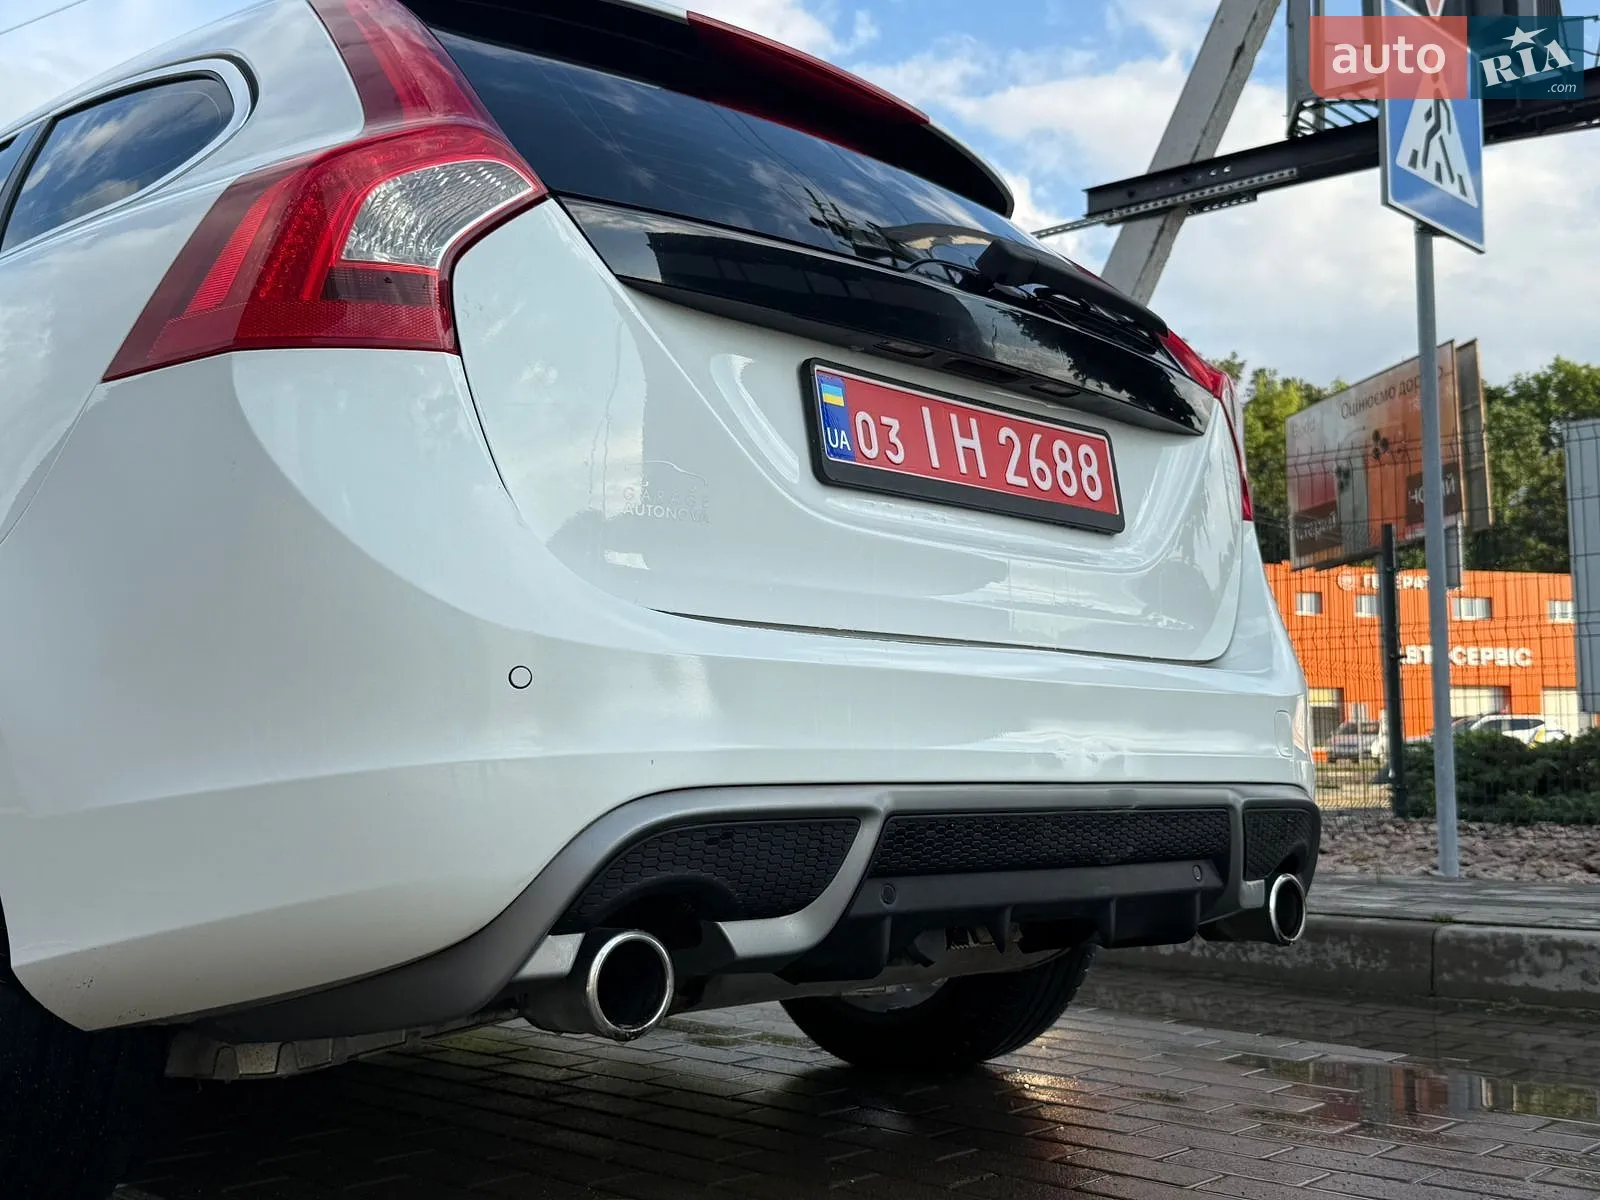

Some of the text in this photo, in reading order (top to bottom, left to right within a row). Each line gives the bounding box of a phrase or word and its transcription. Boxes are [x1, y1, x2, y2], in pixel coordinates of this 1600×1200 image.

[827, 427, 852, 451] UA
[855, 411, 905, 465] 03
[998, 426, 1103, 502] 2688
